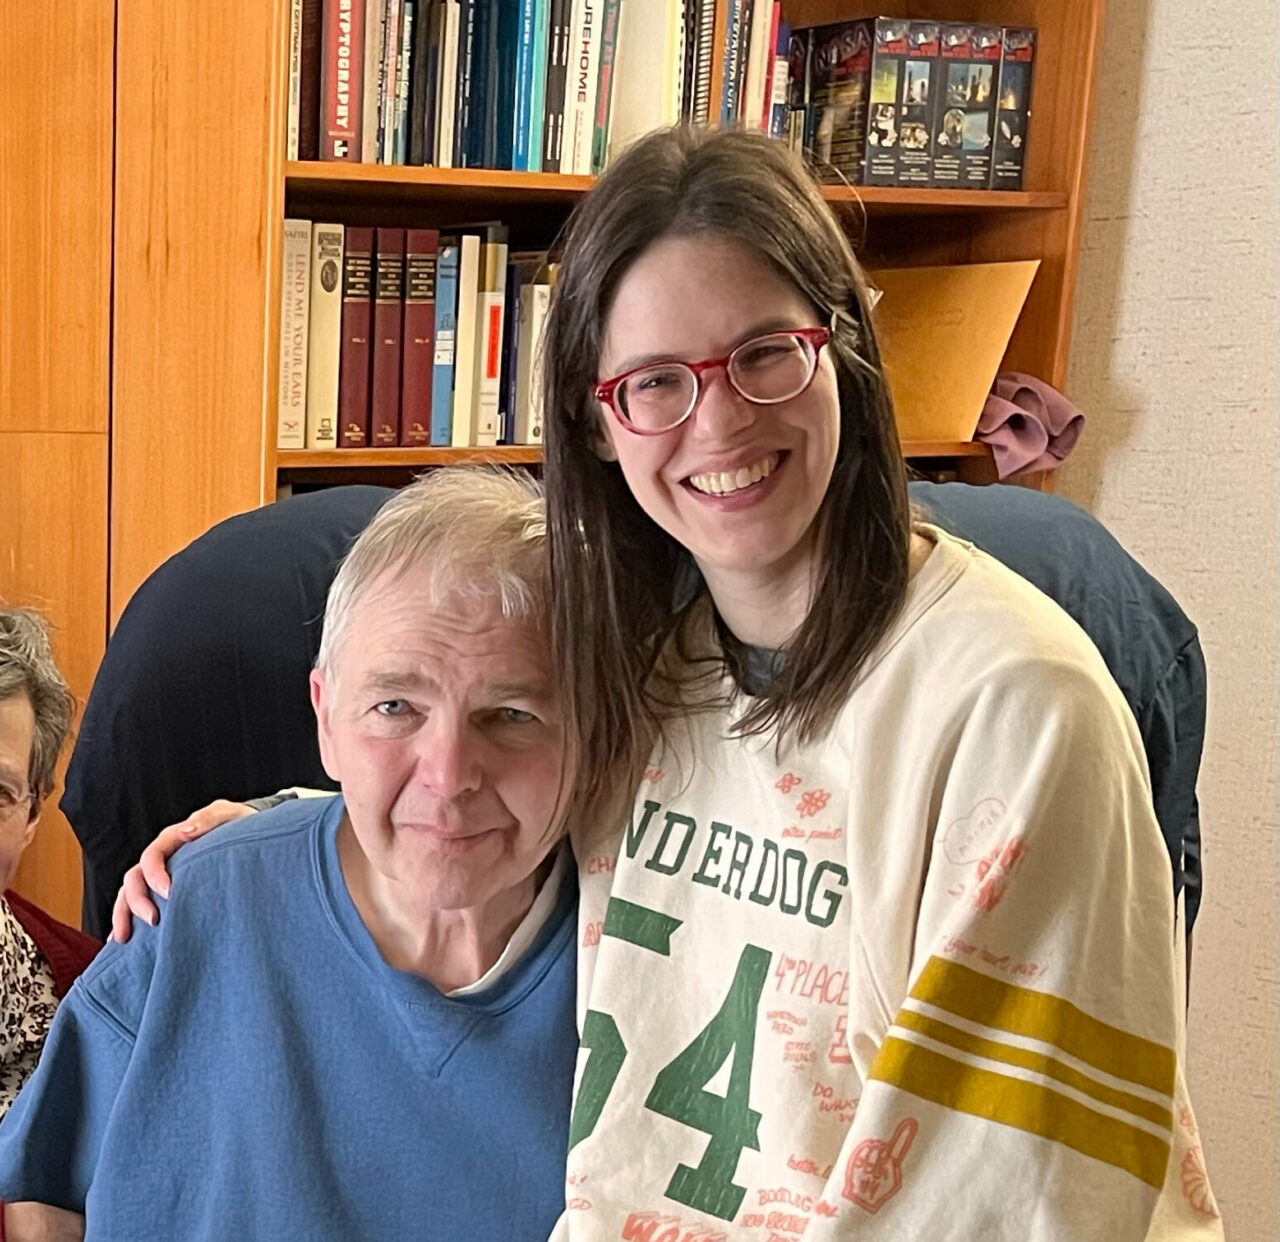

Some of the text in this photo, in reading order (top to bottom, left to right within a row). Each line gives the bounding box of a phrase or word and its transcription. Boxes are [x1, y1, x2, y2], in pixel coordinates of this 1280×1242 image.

[291, 253, 306, 407] LEND ME YOUR EARS
